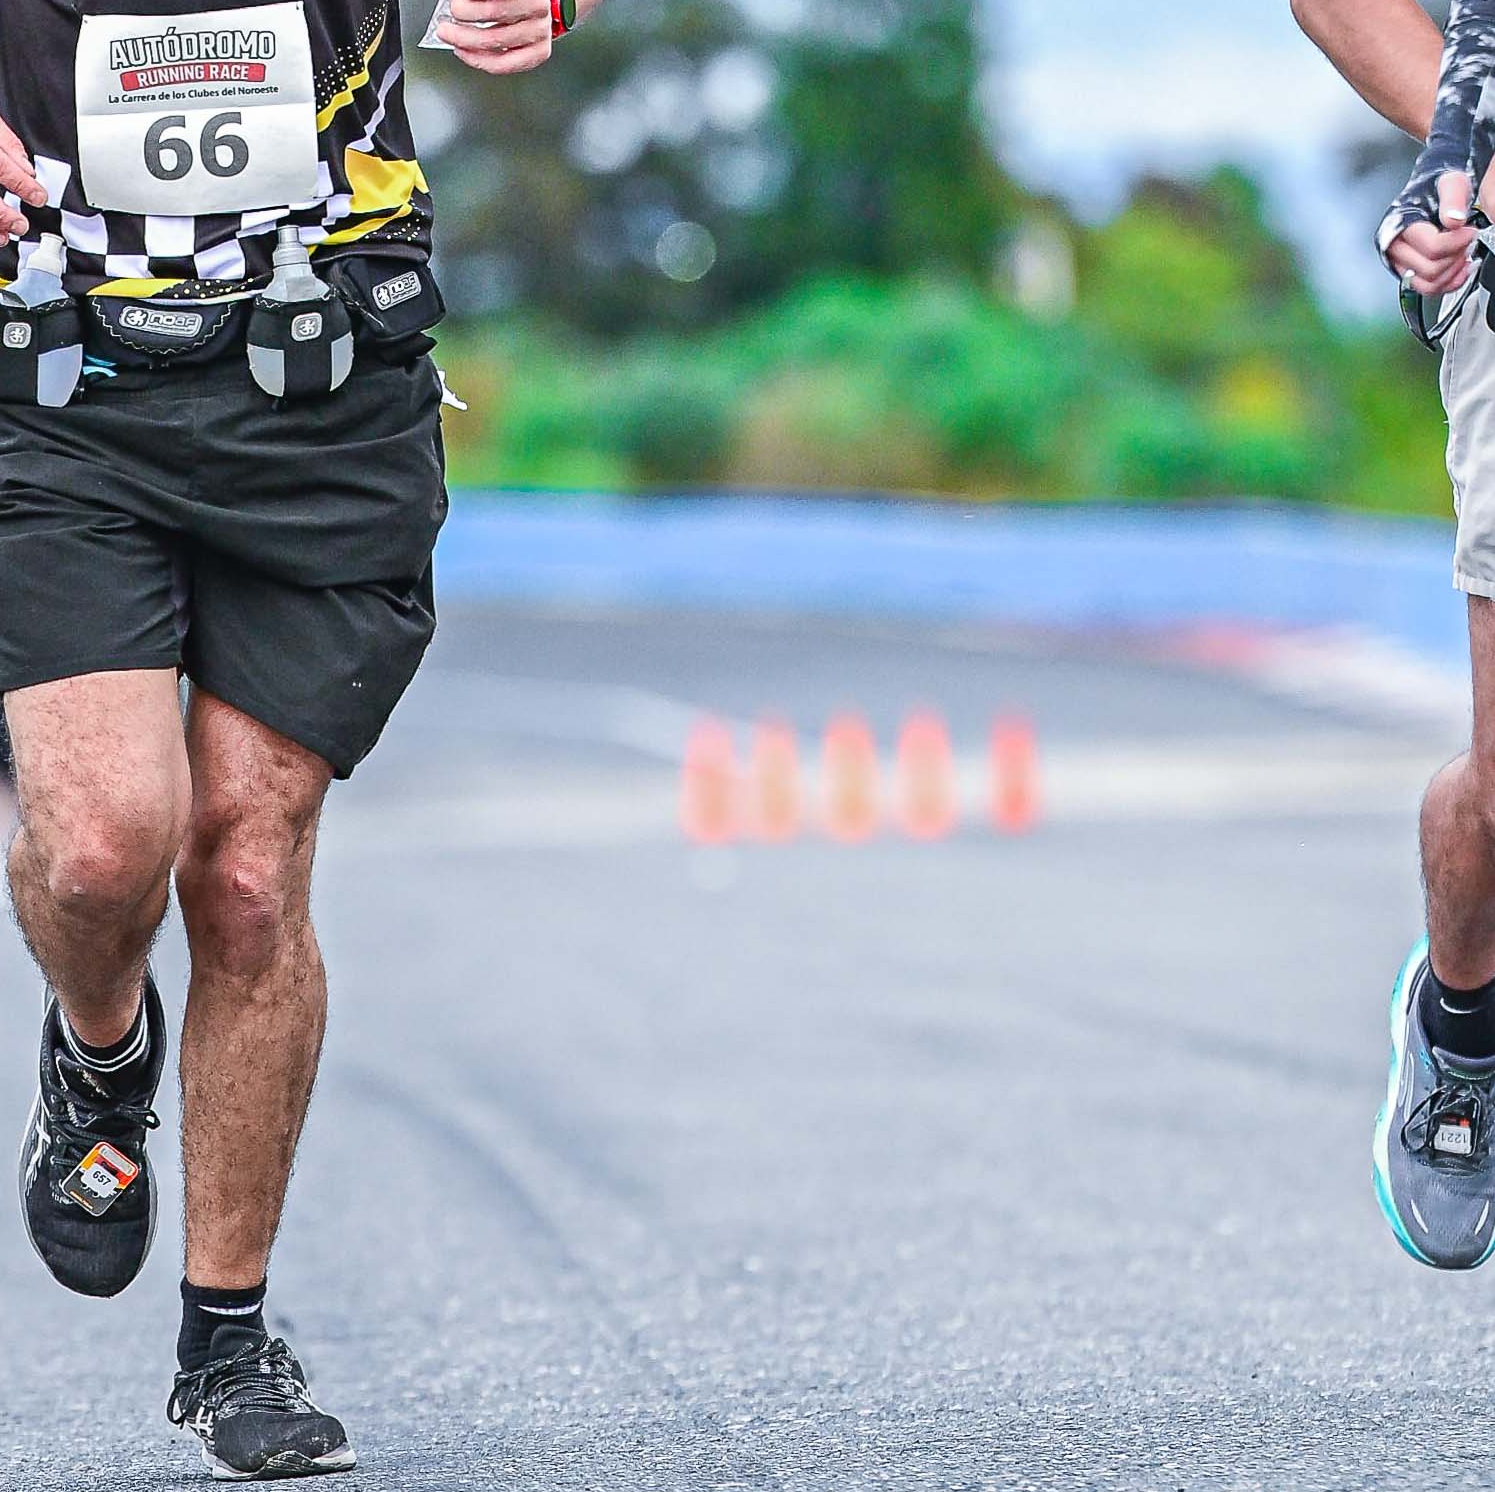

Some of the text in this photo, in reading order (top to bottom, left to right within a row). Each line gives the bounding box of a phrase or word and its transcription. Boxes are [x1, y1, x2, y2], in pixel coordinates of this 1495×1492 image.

[109, 26, 277, 70] AUTÓDROMO
[135, 62, 251, 87] RUNNING RACE
[108, 84, 280, 104] La Carrera de los Clubes del Noroeste
[143, 111, 250, 182] 66
[92, 1170, 112, 1186] 657
